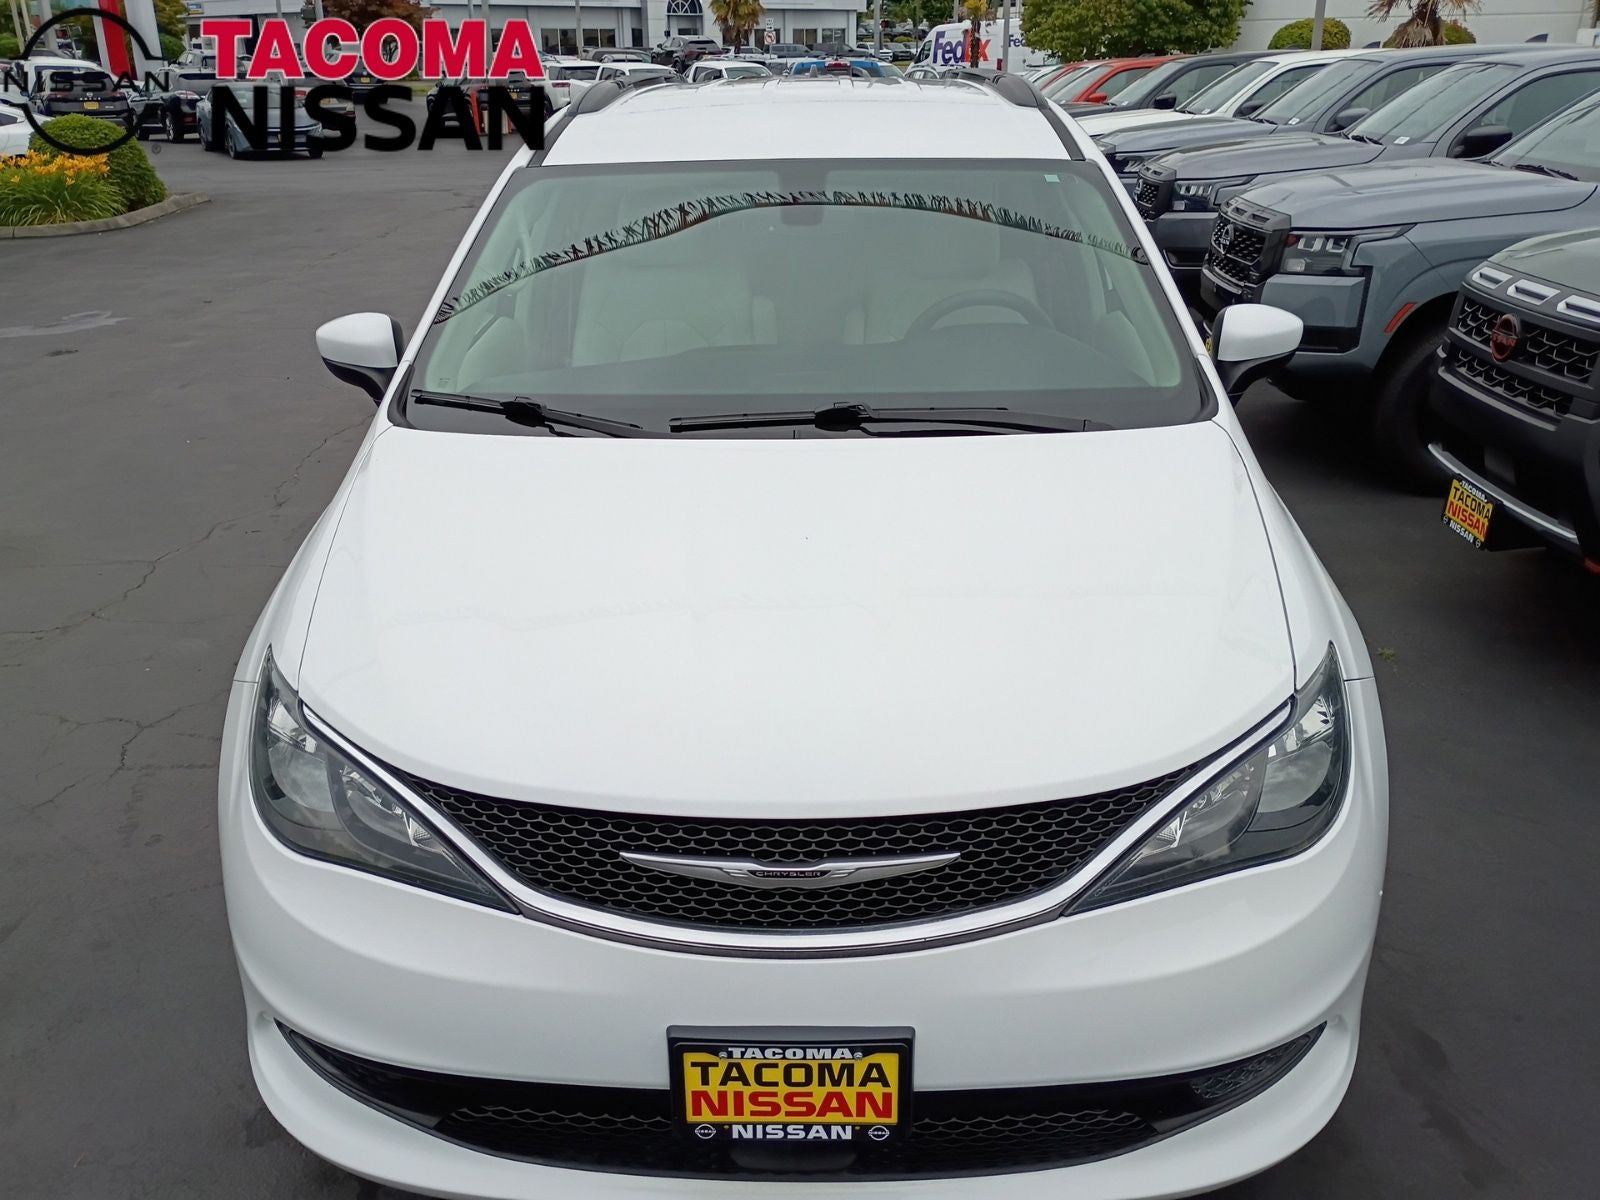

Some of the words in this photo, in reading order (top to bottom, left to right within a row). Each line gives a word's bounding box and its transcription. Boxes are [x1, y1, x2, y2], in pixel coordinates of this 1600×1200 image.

[1453, 486, 1491, 519] TACOMA
[1462, 481, 1485, 501] TACOMA
[1448, 501, 1488, 537] NISSAN
[1449, 520, 1474, 543] NISSAN
[728, 1047, 853, 1060] TACOMA
[690, 1061, 891, 1087] TACOMA
[691, 1090, 893, 1118] NISSAN
[732, 1124, 852, 1140] NISSAN
